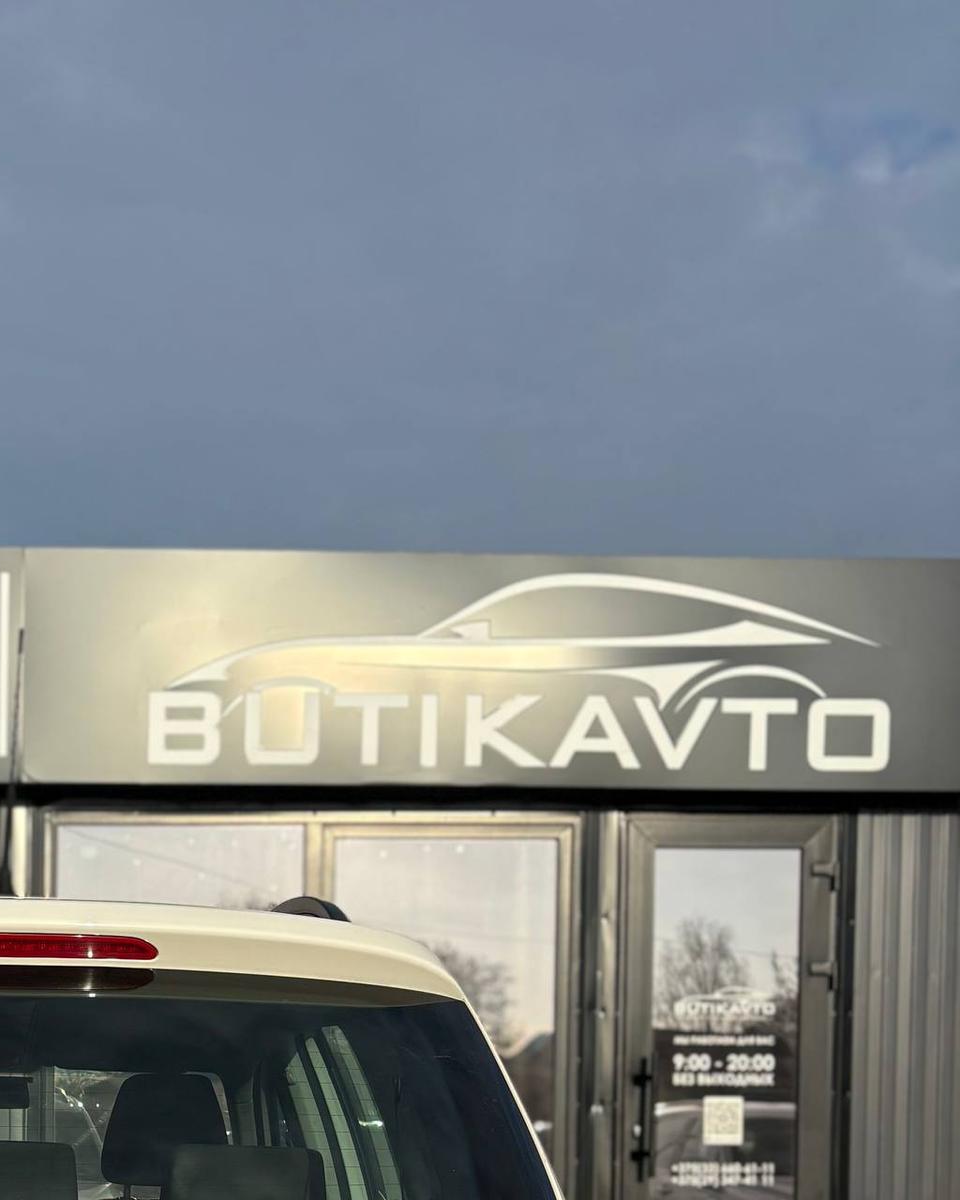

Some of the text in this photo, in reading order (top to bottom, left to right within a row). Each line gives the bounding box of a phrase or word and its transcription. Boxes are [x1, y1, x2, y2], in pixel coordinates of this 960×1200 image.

[146, 690, 891, 772] BUTIKAVTO
[672, 1053, 711, 1072] 9:00
[726, 1053, 775, 1072] 20:00
